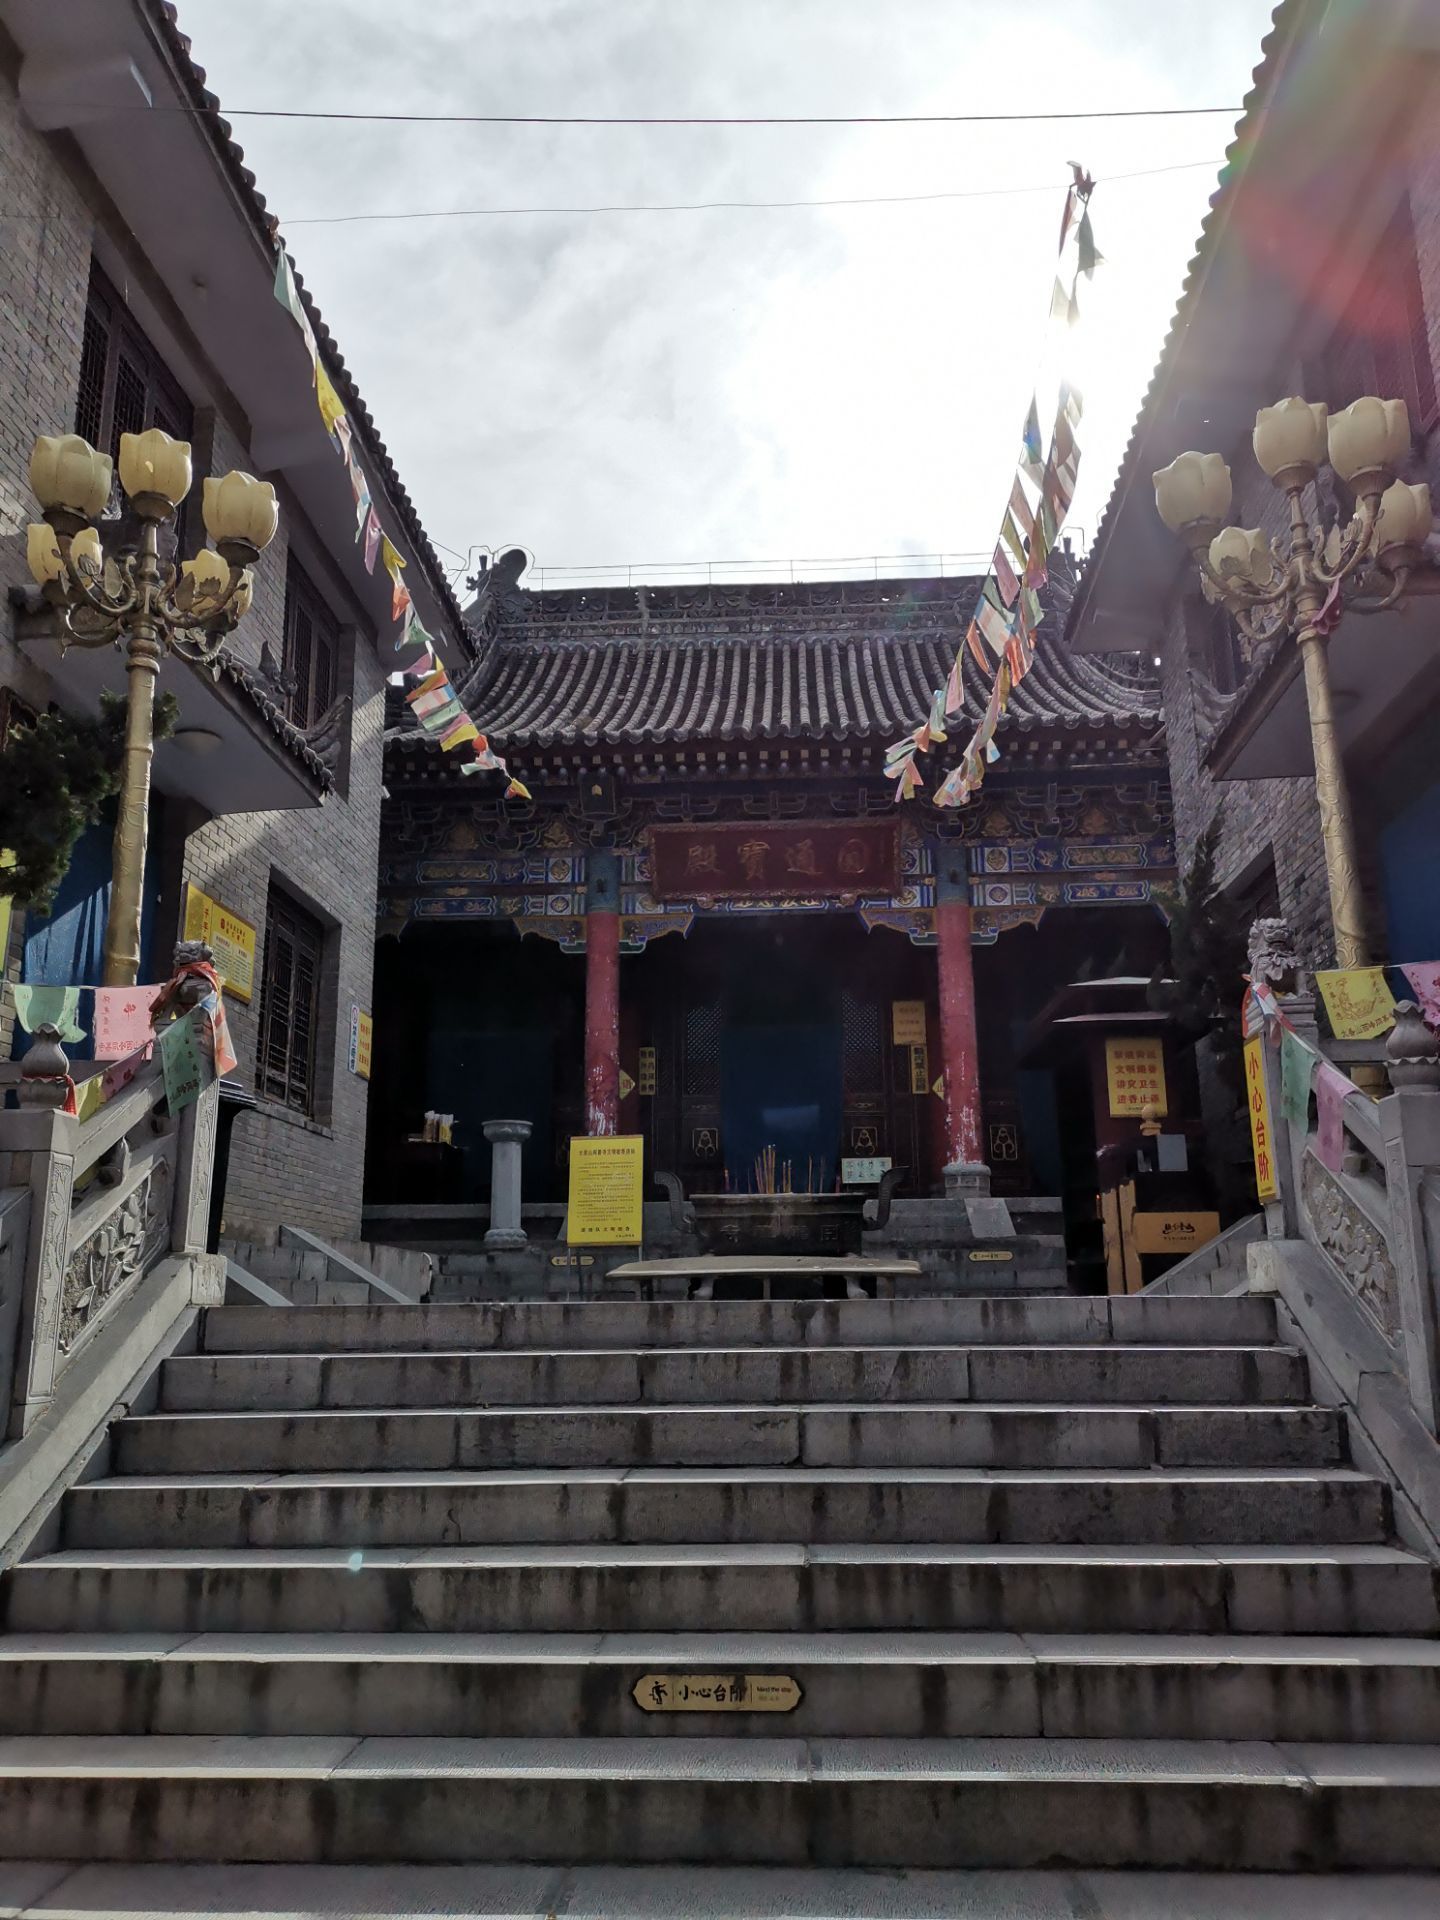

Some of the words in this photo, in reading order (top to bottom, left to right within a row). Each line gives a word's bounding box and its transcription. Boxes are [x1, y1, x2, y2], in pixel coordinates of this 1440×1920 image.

[1116, 1079, 1160, 1089] 讲究卫生
[1249, 1051, 1270, 1182] 小心台阶
[679, 1684, 747, 1703] 小心台阶
